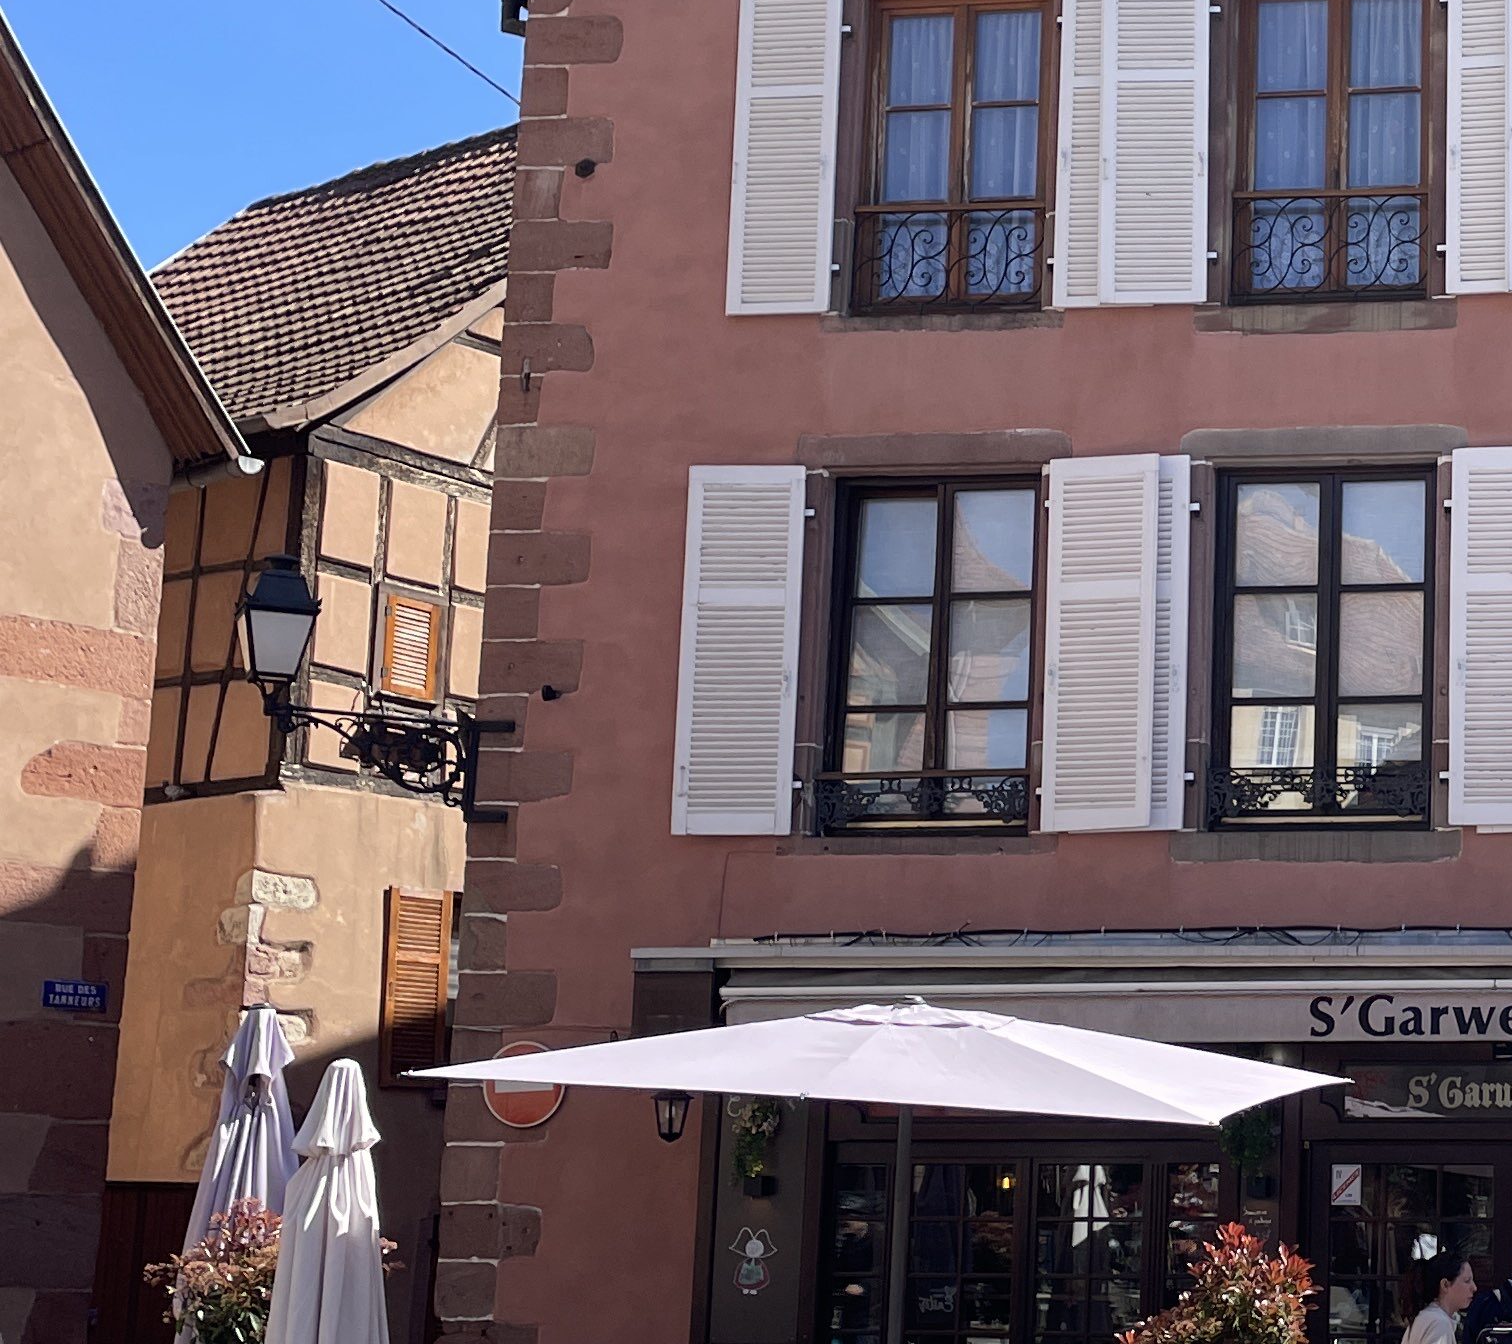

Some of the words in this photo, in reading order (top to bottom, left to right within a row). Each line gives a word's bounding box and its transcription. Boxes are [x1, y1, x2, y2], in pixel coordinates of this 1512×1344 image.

[55, 983, 74, 994] RUE
[77, 985, 97, 995] DES
[49, 994, 101, 1008] TANNEURS
